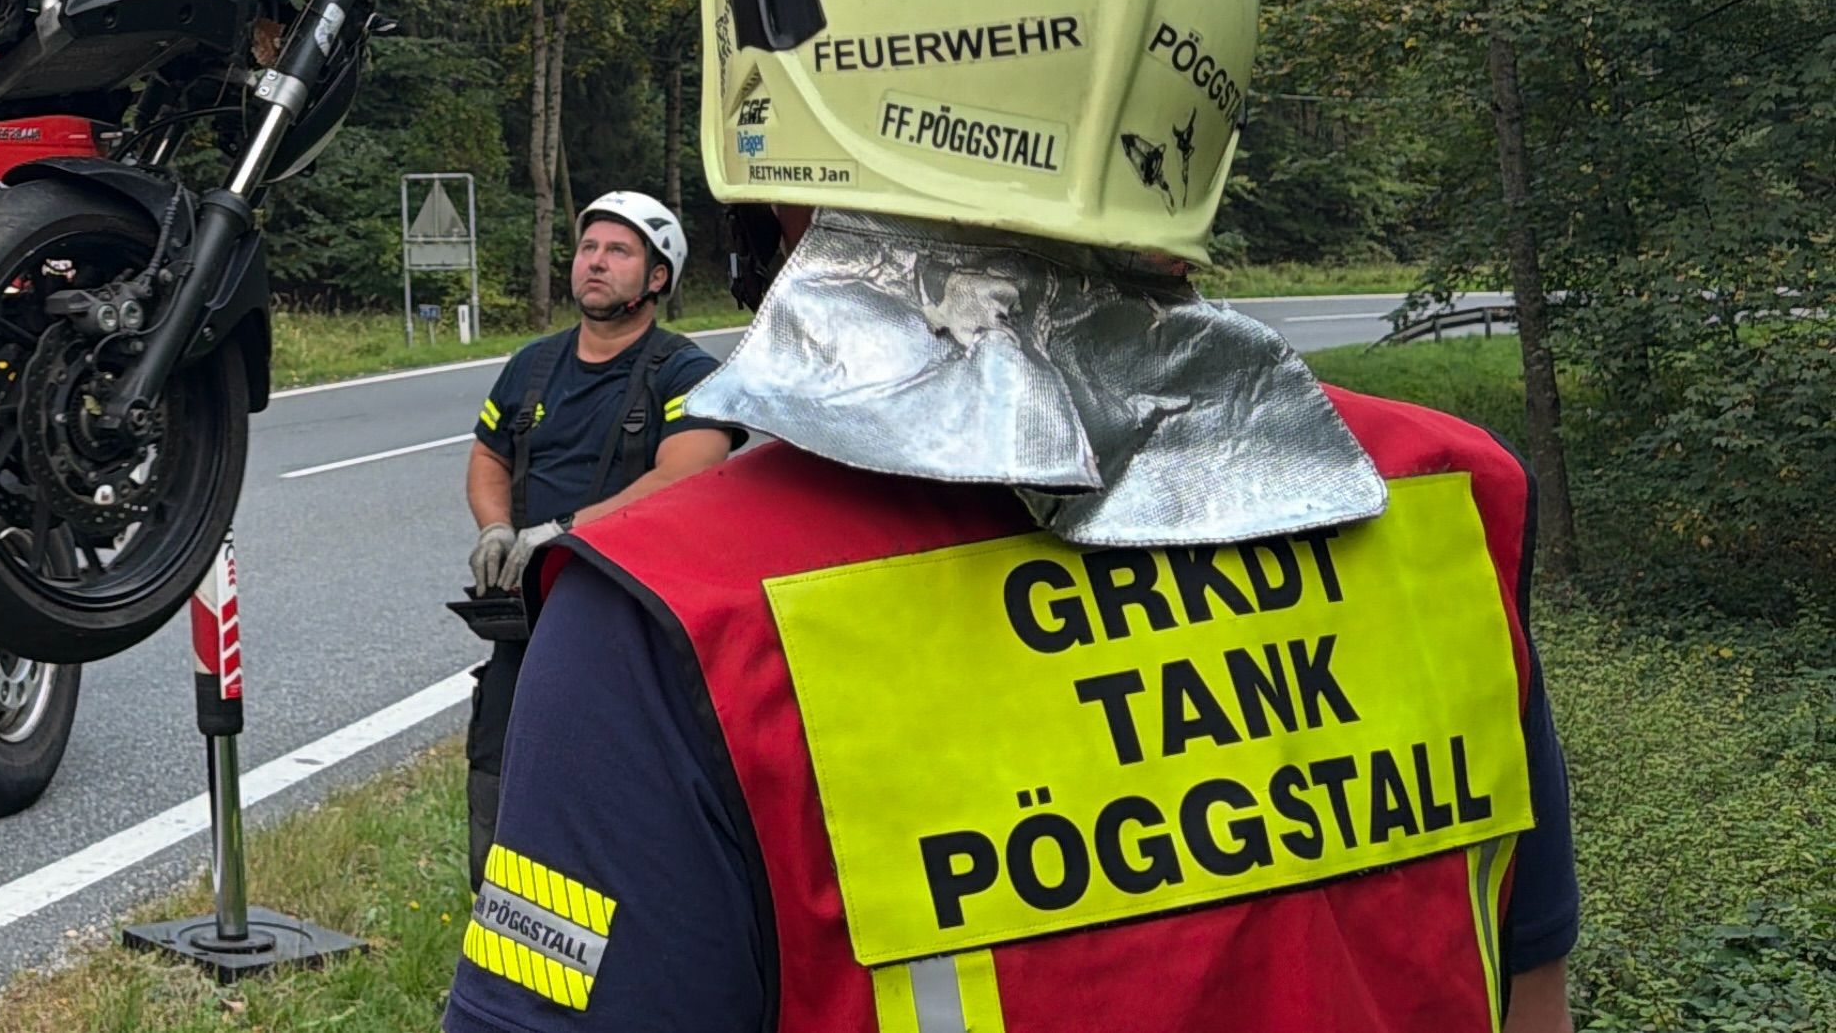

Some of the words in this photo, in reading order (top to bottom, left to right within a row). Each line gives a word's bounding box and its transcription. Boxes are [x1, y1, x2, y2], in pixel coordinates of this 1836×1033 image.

[814, 16, 1083, 73] FEUERWEHR
[737, 130, 765, 157] Dräger
[880, 103, 1059, 172] FF.PÖGGSTALL
[749, 165, 814, 182] REITHNER
[818, 166, 850, 183] Jan
[1003, 532, 1344, 655] GRKDT
[1073, 633, 1361, 766] TANK
[917, 734, 1494, 930] PÖGGSTALL
[485, 899, 588, 966] PÖGGSTALL
